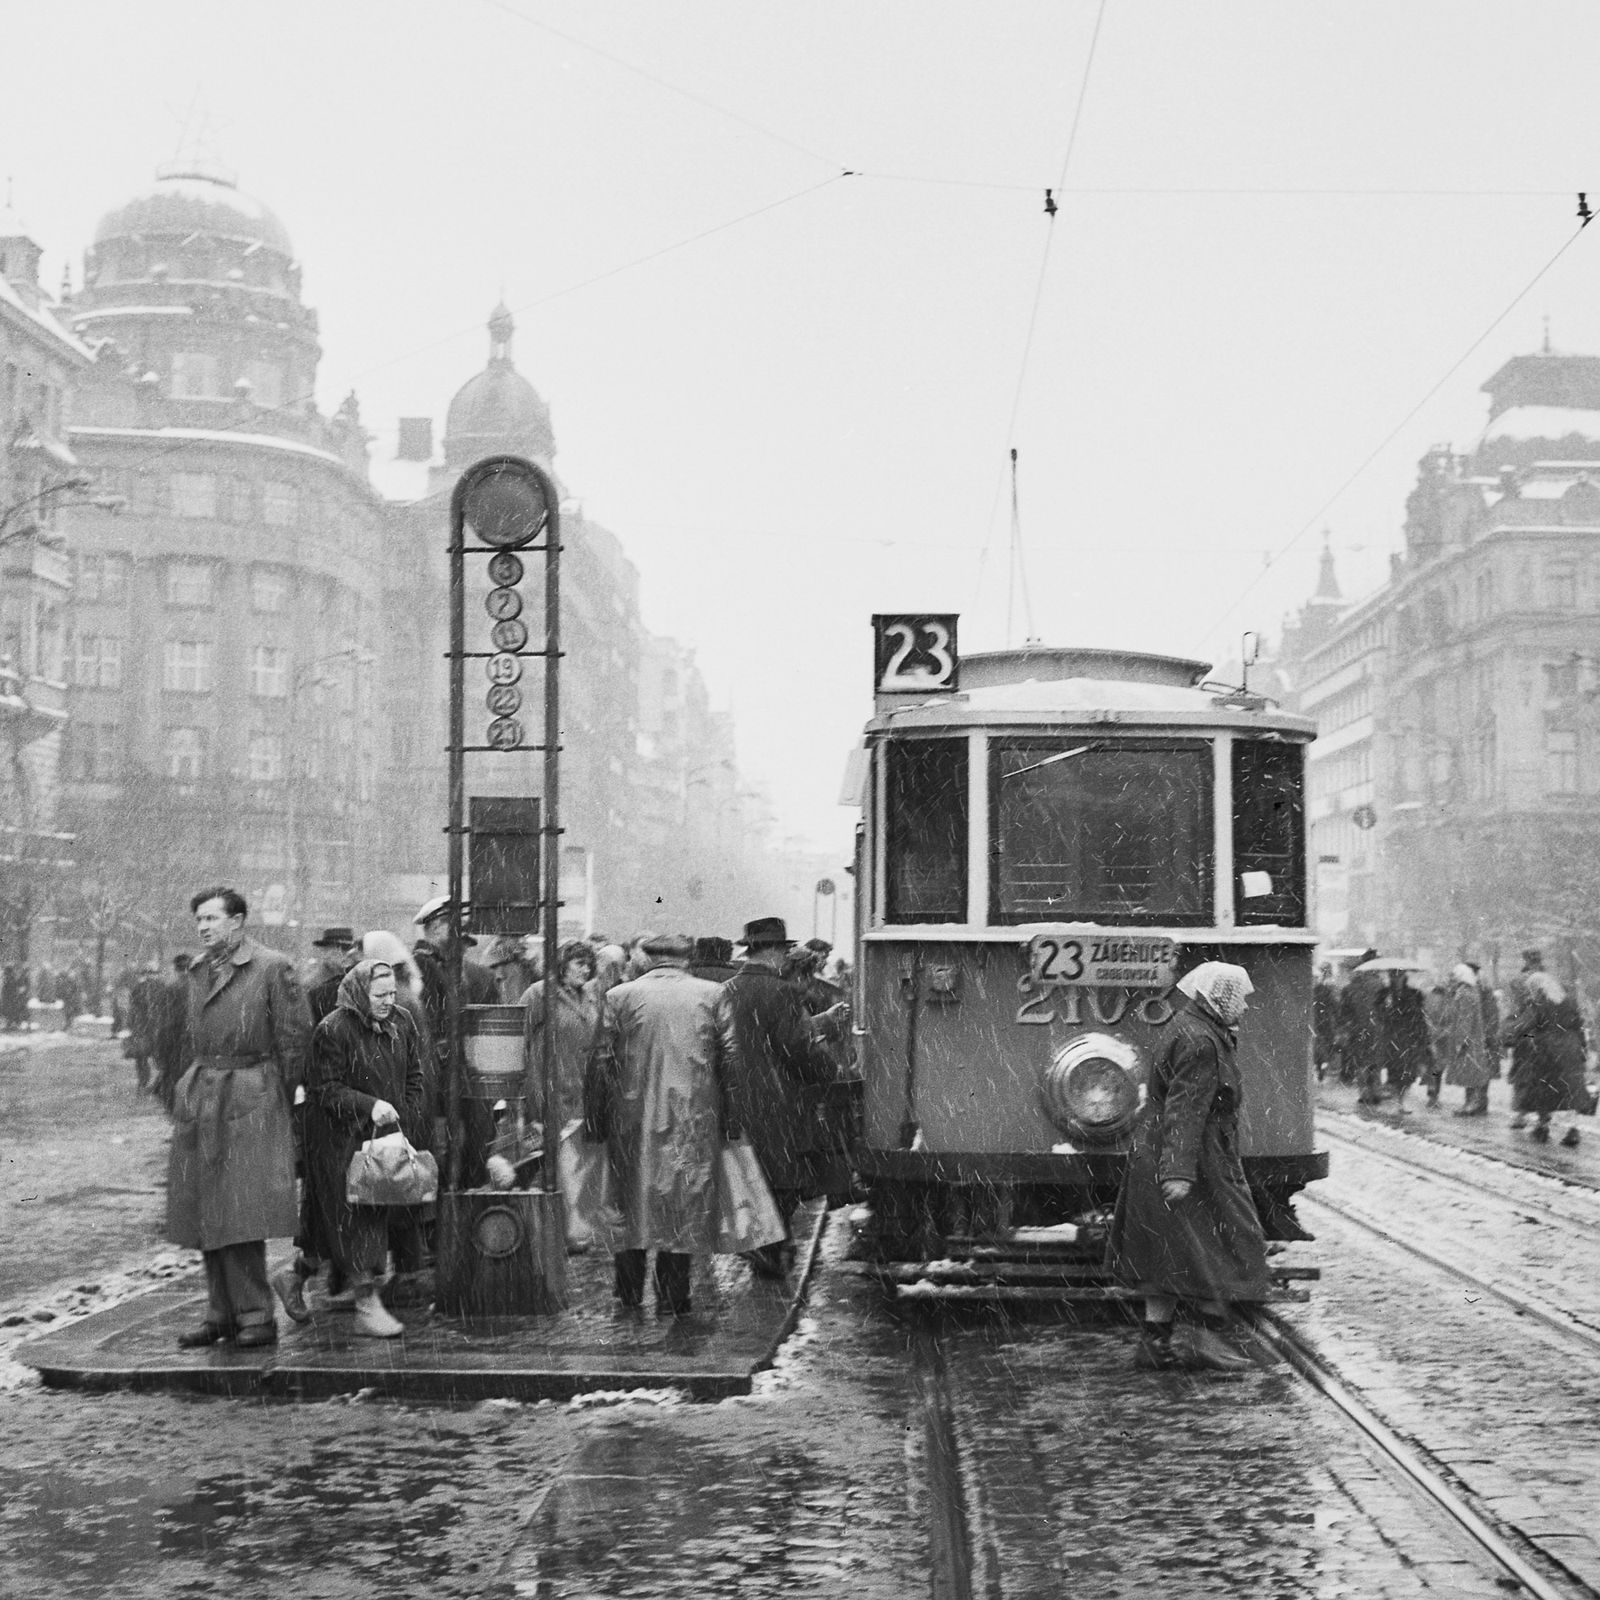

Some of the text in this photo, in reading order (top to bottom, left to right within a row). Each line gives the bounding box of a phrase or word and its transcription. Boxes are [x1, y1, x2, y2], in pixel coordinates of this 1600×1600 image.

[498, 592, 510, 614] 7
[880, 621, 953, 690] 23
[492, 657, 513, 680] 19
[492, 687, 516, 712] 22
[1039, 939, 1084, 980] 23
